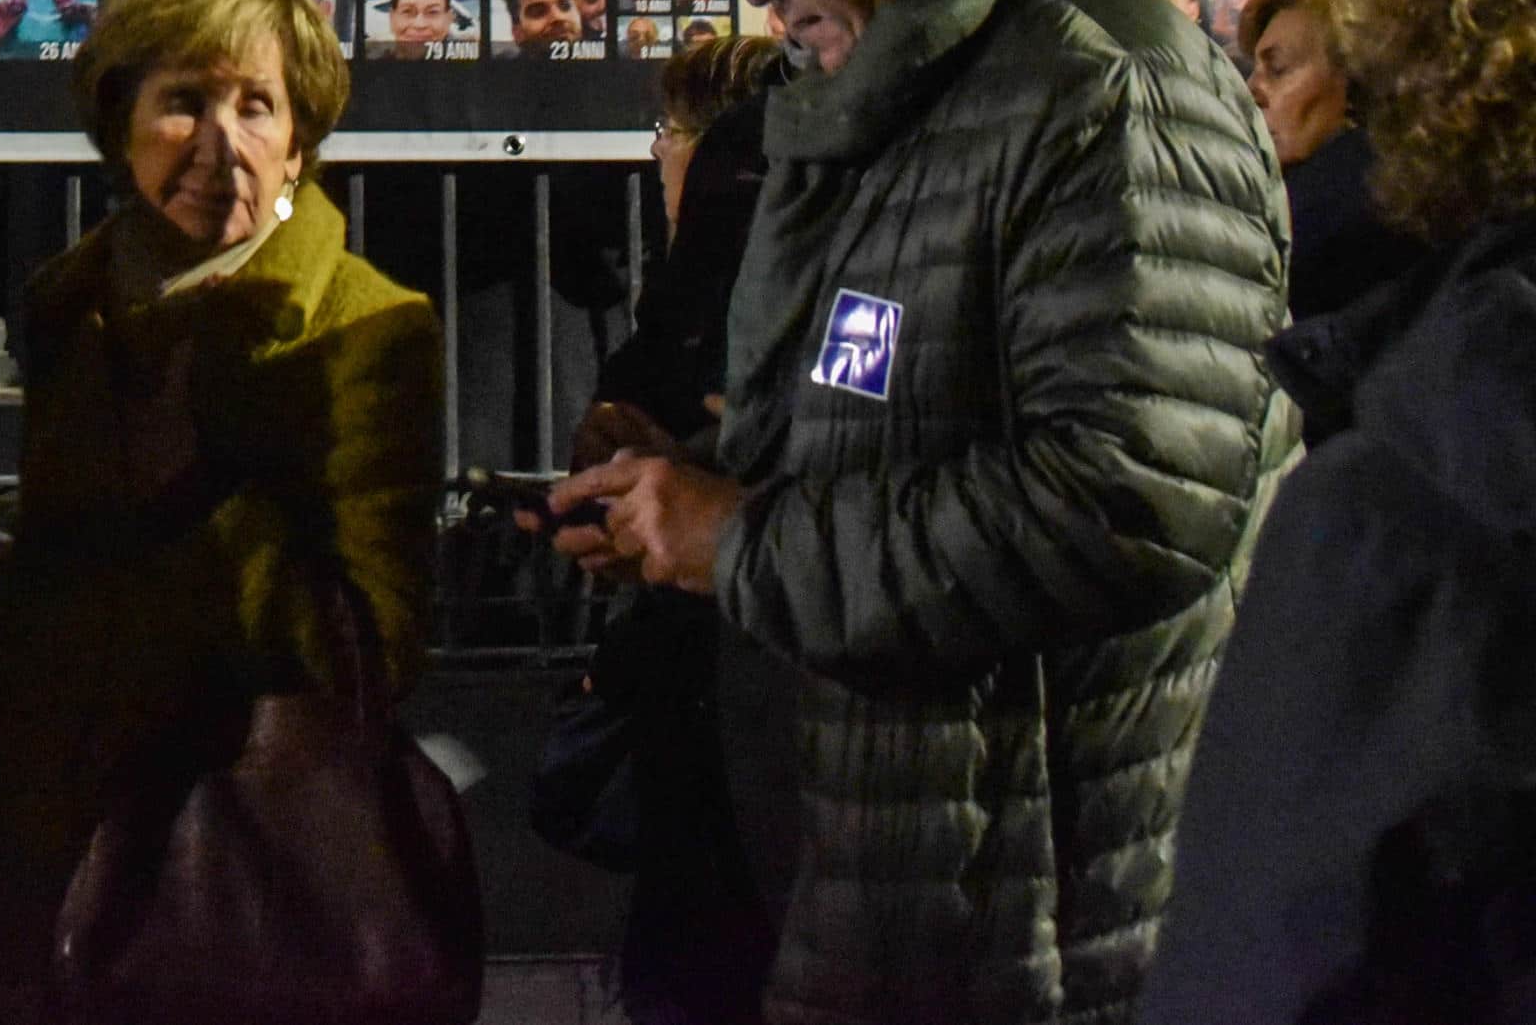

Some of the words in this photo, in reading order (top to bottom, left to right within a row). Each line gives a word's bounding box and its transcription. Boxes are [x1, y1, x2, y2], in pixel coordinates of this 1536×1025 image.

[39, 42, 58, 60] 26
[61, 42, 81, 60] AN
[424, 41, 443, 60] 79
[445, 41, 480, 60] ANNI
[549, 41, 569, 60] 23
[571, 41, 606, 60] ANNI
